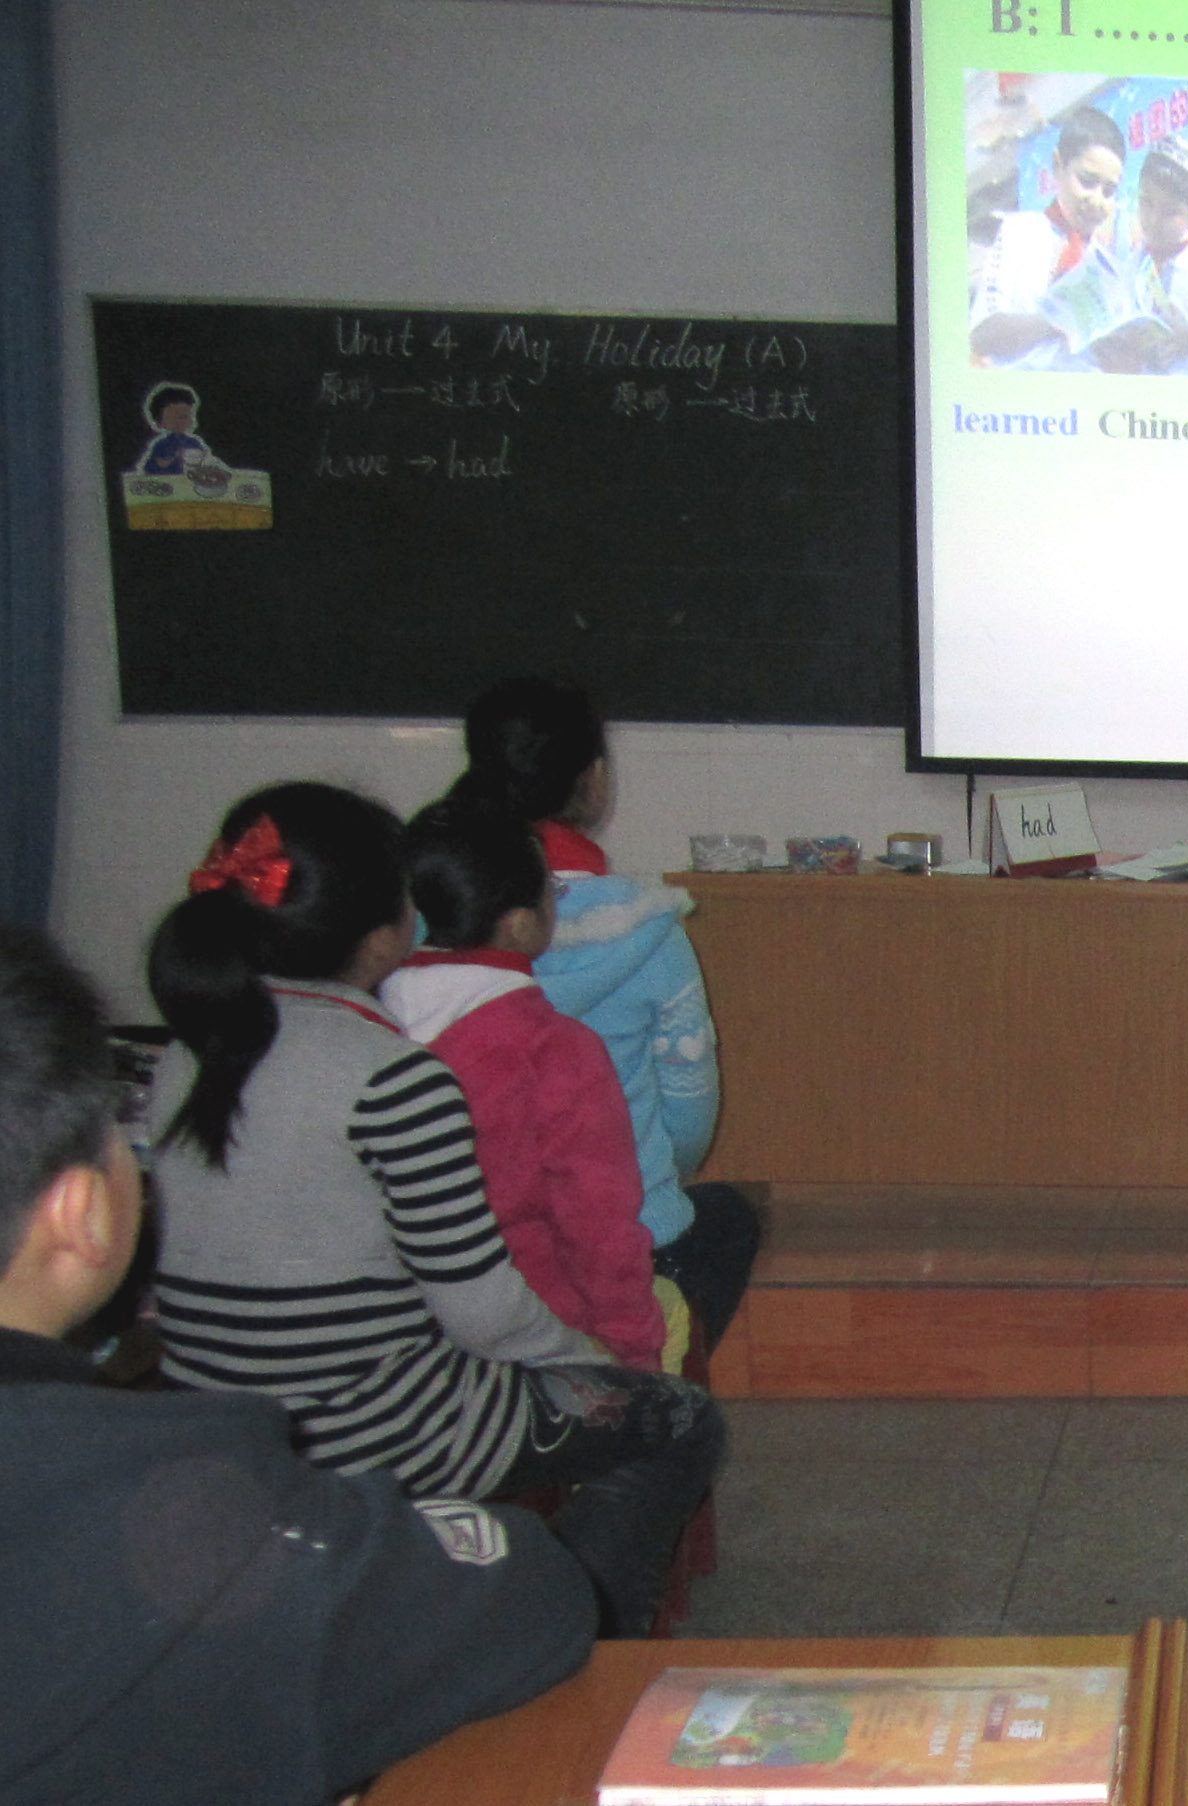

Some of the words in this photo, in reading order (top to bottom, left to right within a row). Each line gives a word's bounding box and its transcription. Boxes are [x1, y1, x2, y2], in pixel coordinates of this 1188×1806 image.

[335, 316, 416, 357] Unit
[431, 326, 459, 359] 4
[492, 324, 553, 385] My
[583, 321, 726, 391] Holiday
[744, 335, 808, 368] (A)
[953, 403, 1079, 436] learned
[447, 433, 513, 479] had
[1020, 803, 1058, 839] had
